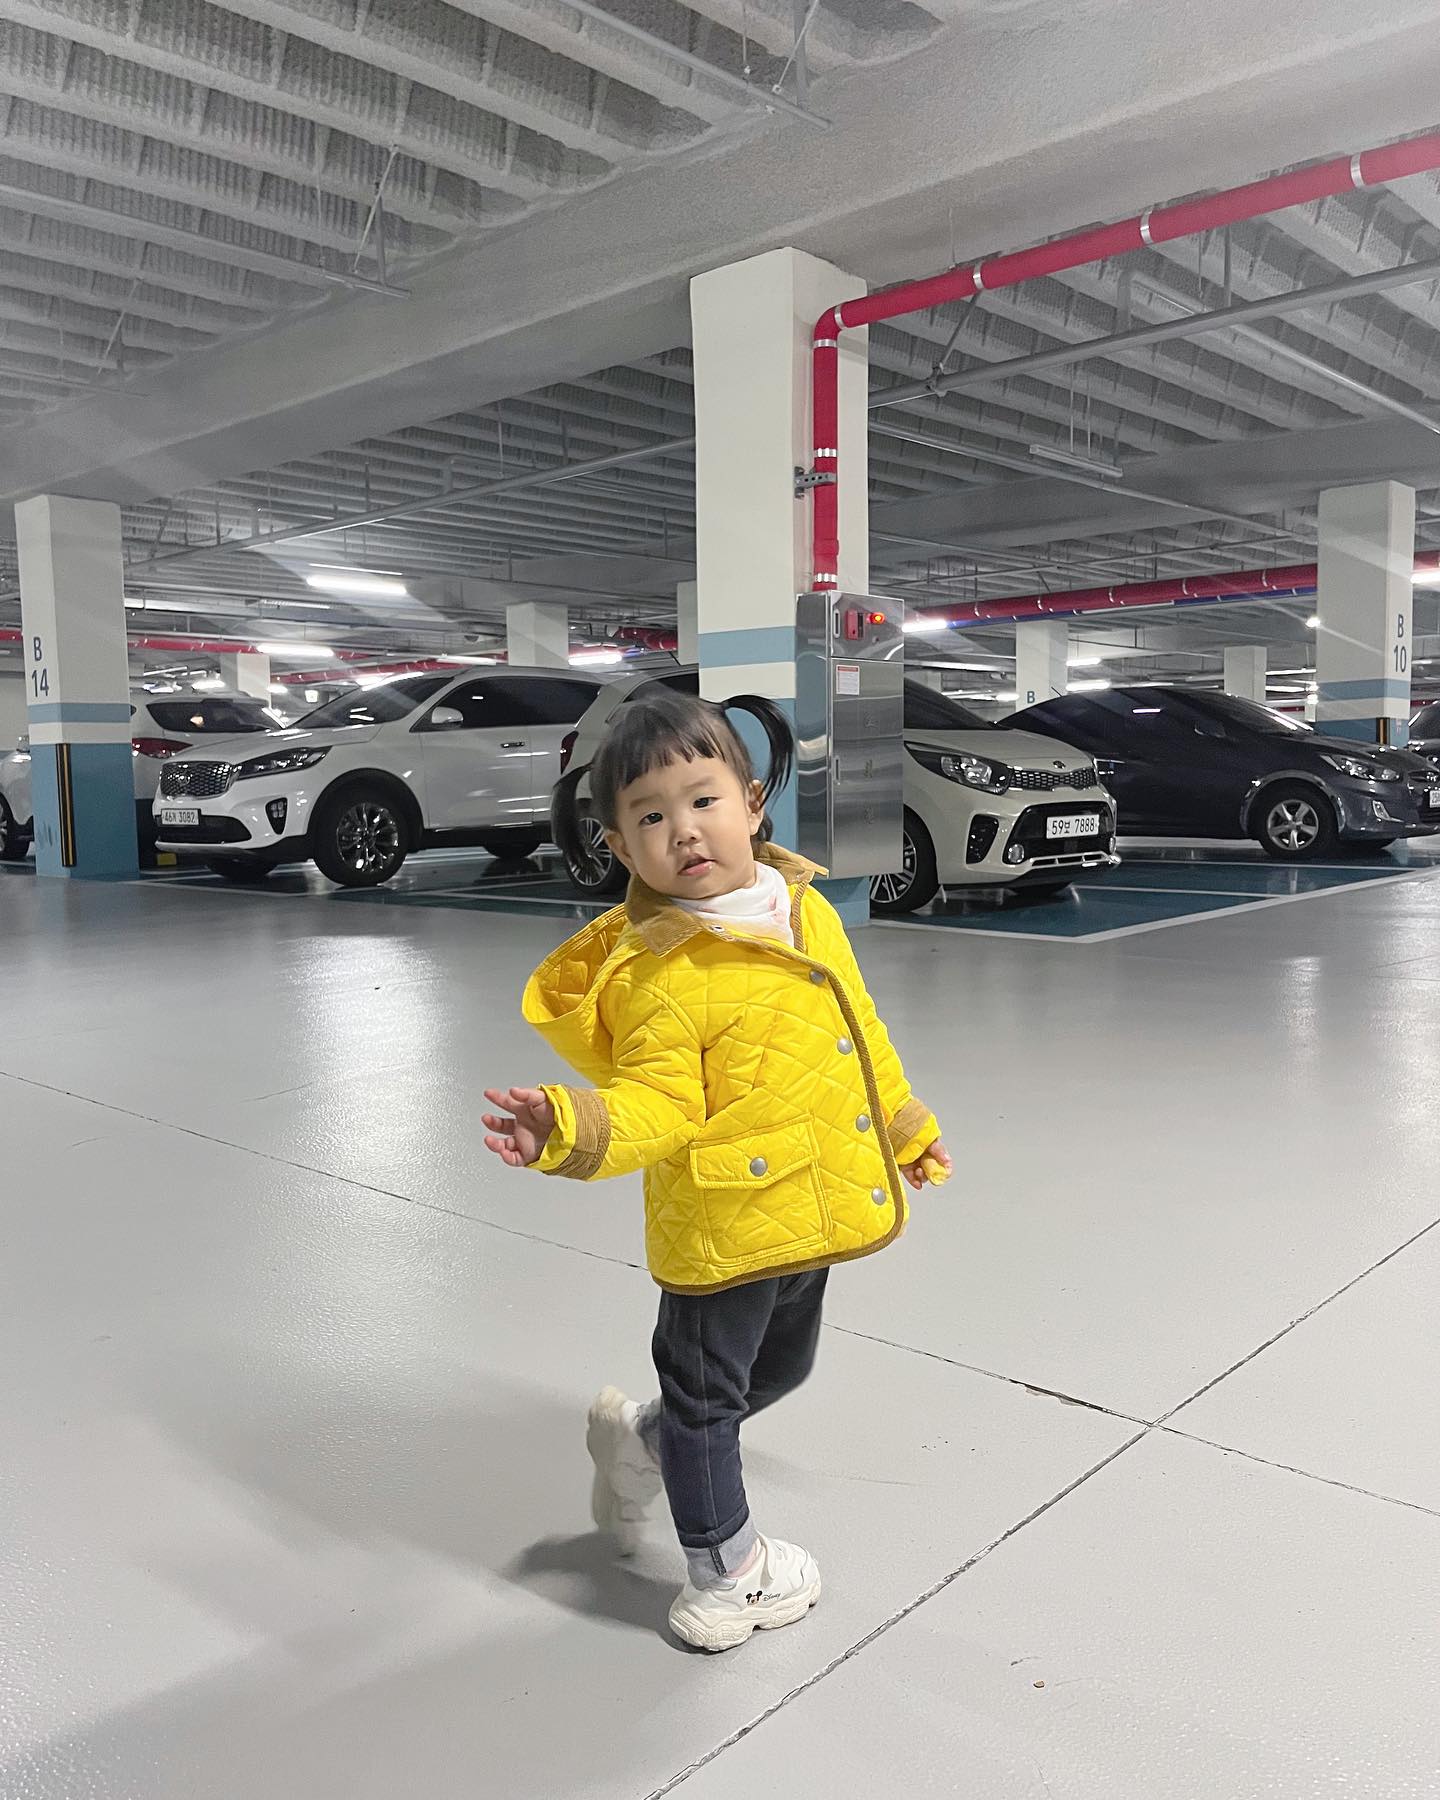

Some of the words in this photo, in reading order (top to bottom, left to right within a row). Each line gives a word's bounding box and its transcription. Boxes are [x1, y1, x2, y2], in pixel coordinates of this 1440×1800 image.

[1397, 613, 1405, 639] B
[33, 636, 43, 662] B
[1393, 644, 1407, 673] 10
[31, 668, 50, 698] 14
[1026, 690, 1036, 704] B
[1051, 819, 1071, 836] 59보
[1074, 817, 1095, 834] 7888
